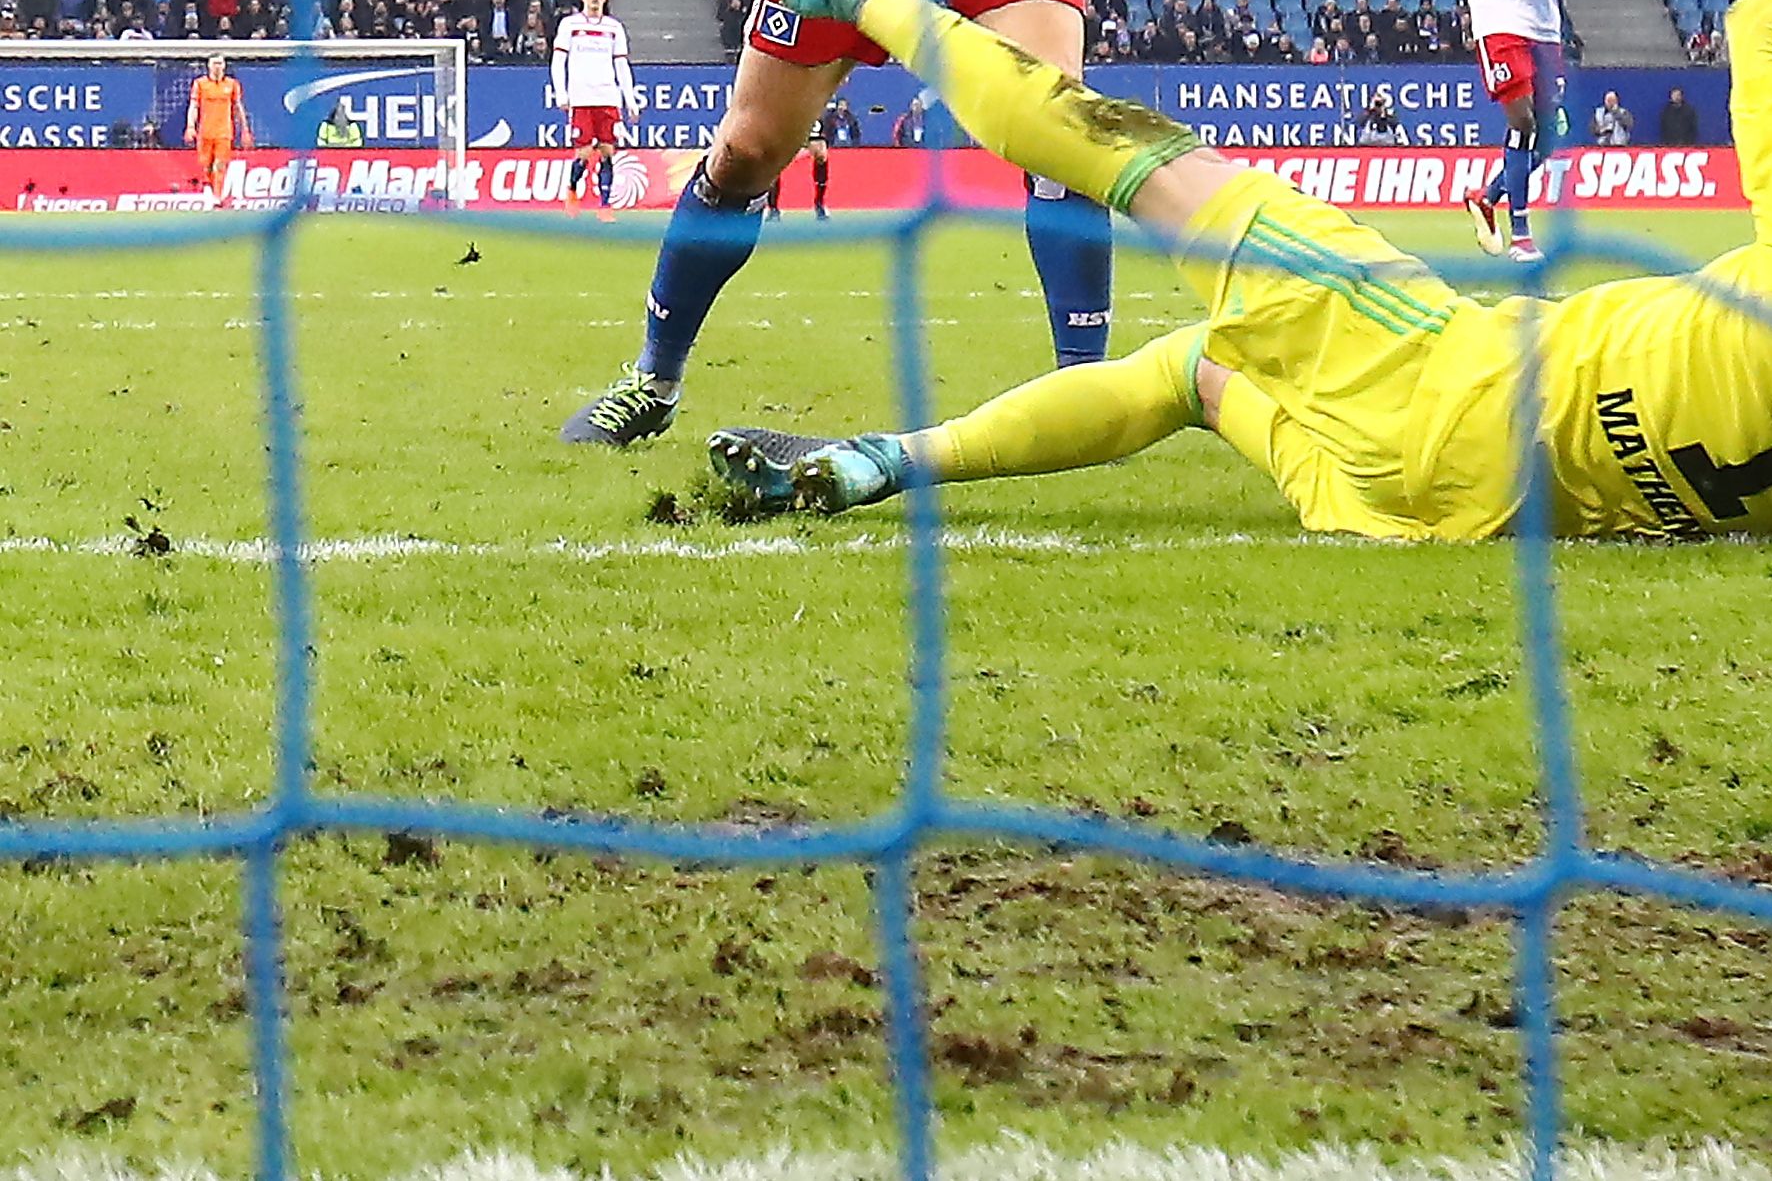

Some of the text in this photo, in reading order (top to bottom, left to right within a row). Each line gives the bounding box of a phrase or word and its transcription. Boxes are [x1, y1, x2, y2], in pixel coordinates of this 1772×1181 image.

[1178, 82, 1475, 110] HANSEATISCHE
[1364, 157, 1446, 203] IHR
[1575, 152, 1717, 198] SPASS.
[1596, 387, 1703, 535] MATHEN
